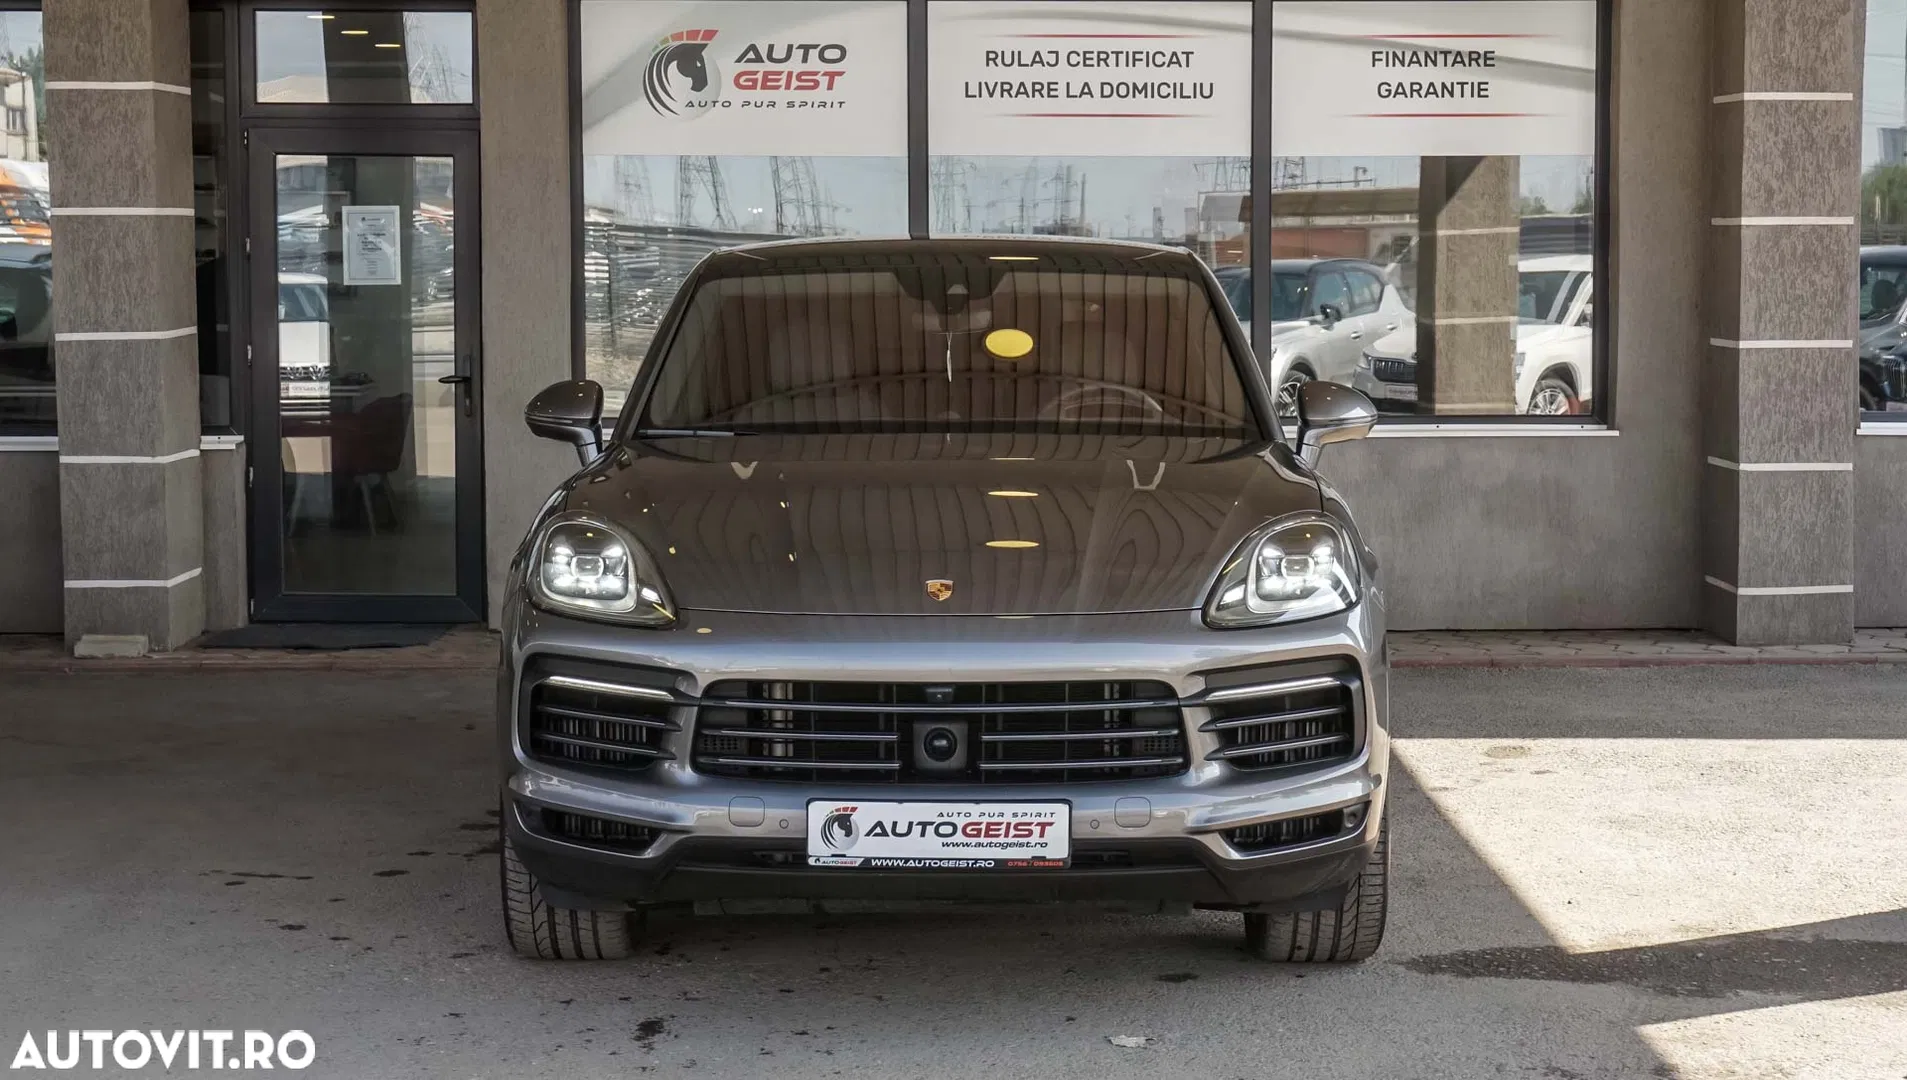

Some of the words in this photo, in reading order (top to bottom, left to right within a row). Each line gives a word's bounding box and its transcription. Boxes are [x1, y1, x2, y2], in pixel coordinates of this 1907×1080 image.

[734, 43, 847, 64] AUTO
[985, 50, 1060, 68] RULAJ
[1066, 50, 1195, 68] CERTIFICAT
[1371, 50, 1496, 68] FINANTARE
[733, 70, 846, 91] GEIST
[964, 81, 1060, 99] LIVRARE
[1065, 82, 1095, 99] LA
[1100, 82, 1215, 100] DOMICILIU
[1377, 81, 1490, 99] GARANTIE
[685, 100, 732, 108] AUTO
[741, 100, 777, 108] PUR
[786, 101, 846, 109] SPIRIT
[864, 820, 1056, 839] AUTOGEIST
[941, 840, 1049, 850] www.autogeist.ro
[871, 858, 995, 868] WWW.AUTOGEIST.RO
